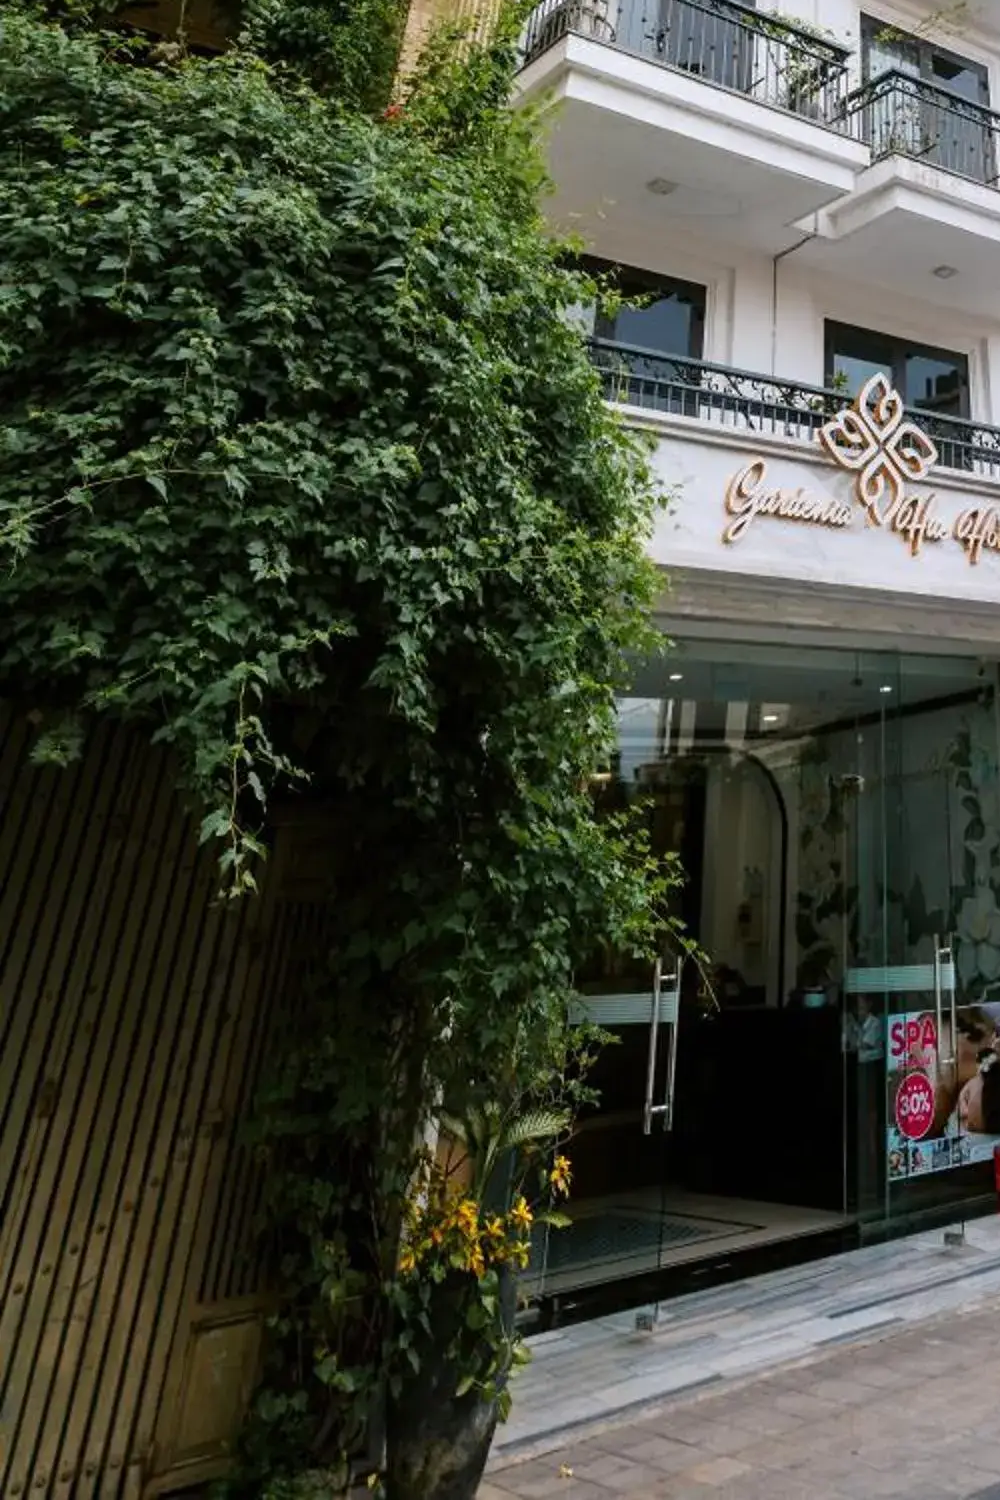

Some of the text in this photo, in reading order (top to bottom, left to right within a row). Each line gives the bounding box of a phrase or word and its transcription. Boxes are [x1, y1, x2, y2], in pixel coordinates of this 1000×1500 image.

[721, 457, 852, 544] Gardenia
[891, 1019, 936, 1057] SPA
[900, 1090, 931, 1117] 30%
